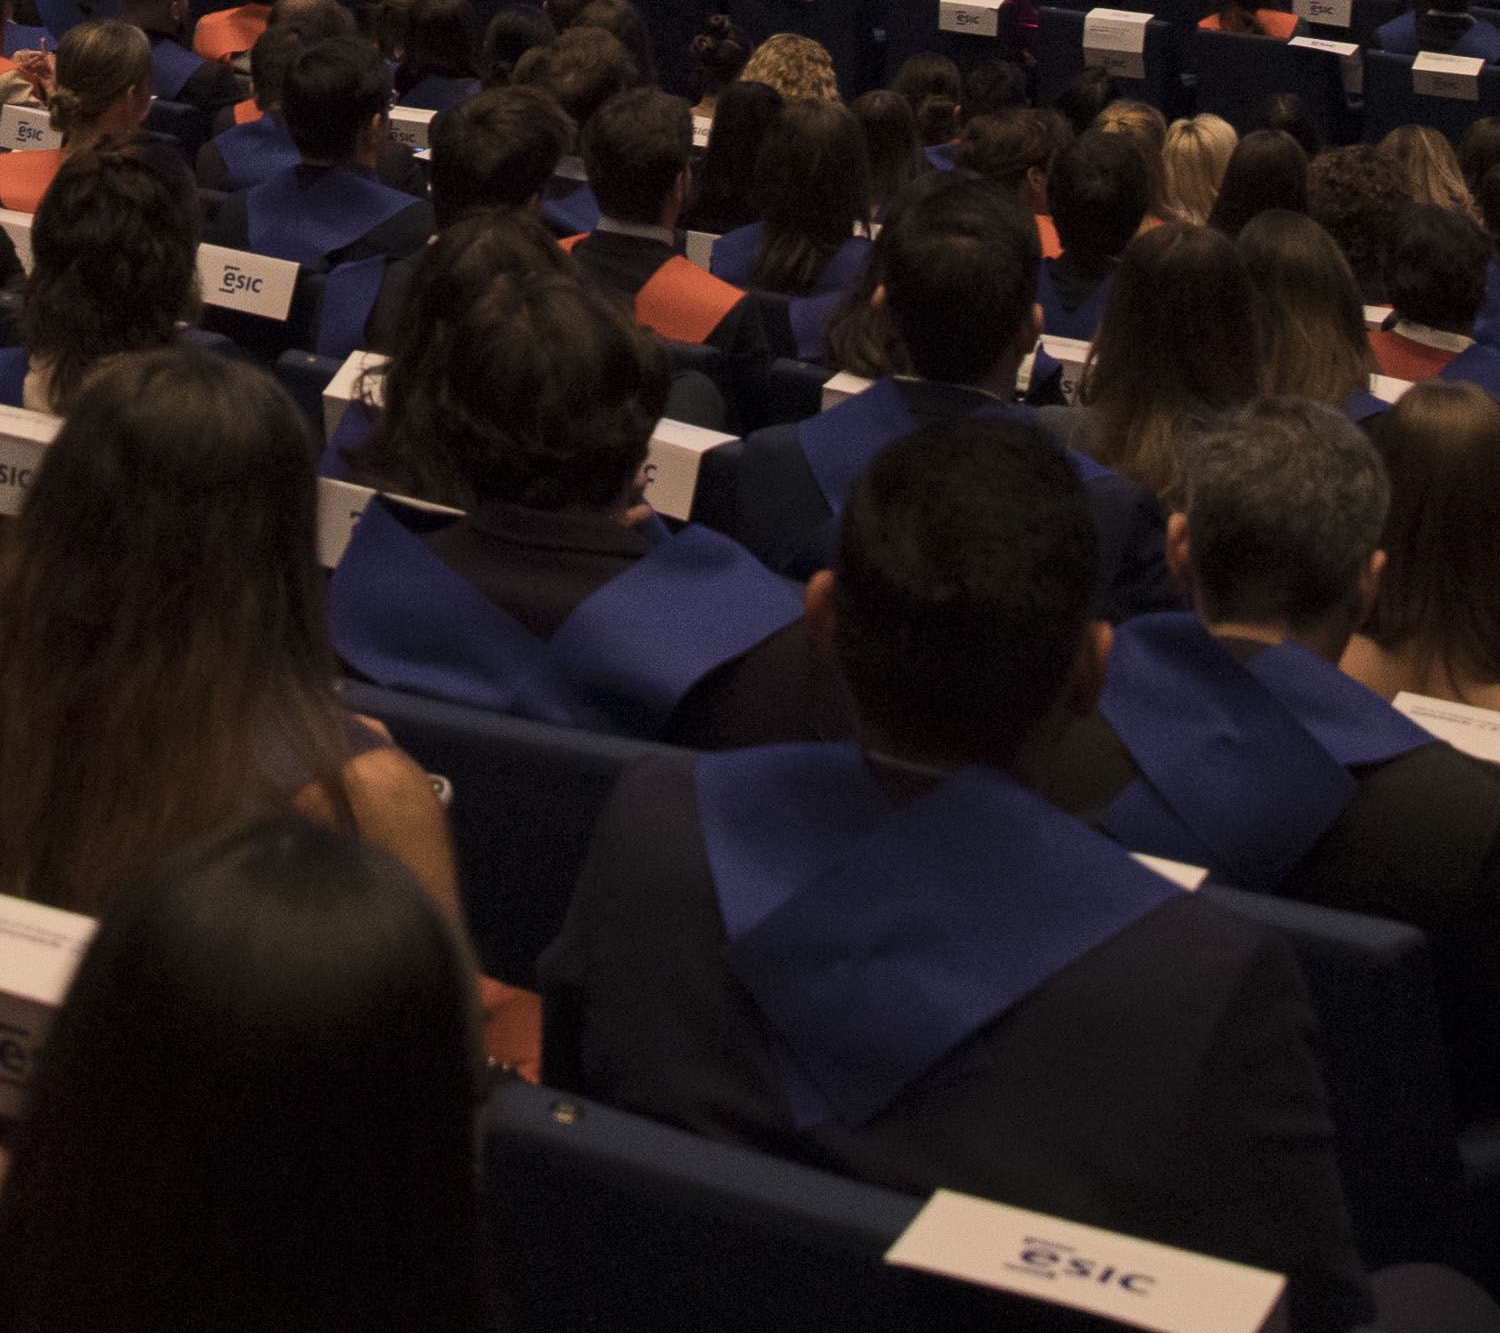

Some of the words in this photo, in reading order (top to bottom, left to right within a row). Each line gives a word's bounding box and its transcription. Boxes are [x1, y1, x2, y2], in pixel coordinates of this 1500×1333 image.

[18, 125, 43, 141] esic
[223, 271, 263, 294] esic
[1017, 1246, 1158, 1297] esic
